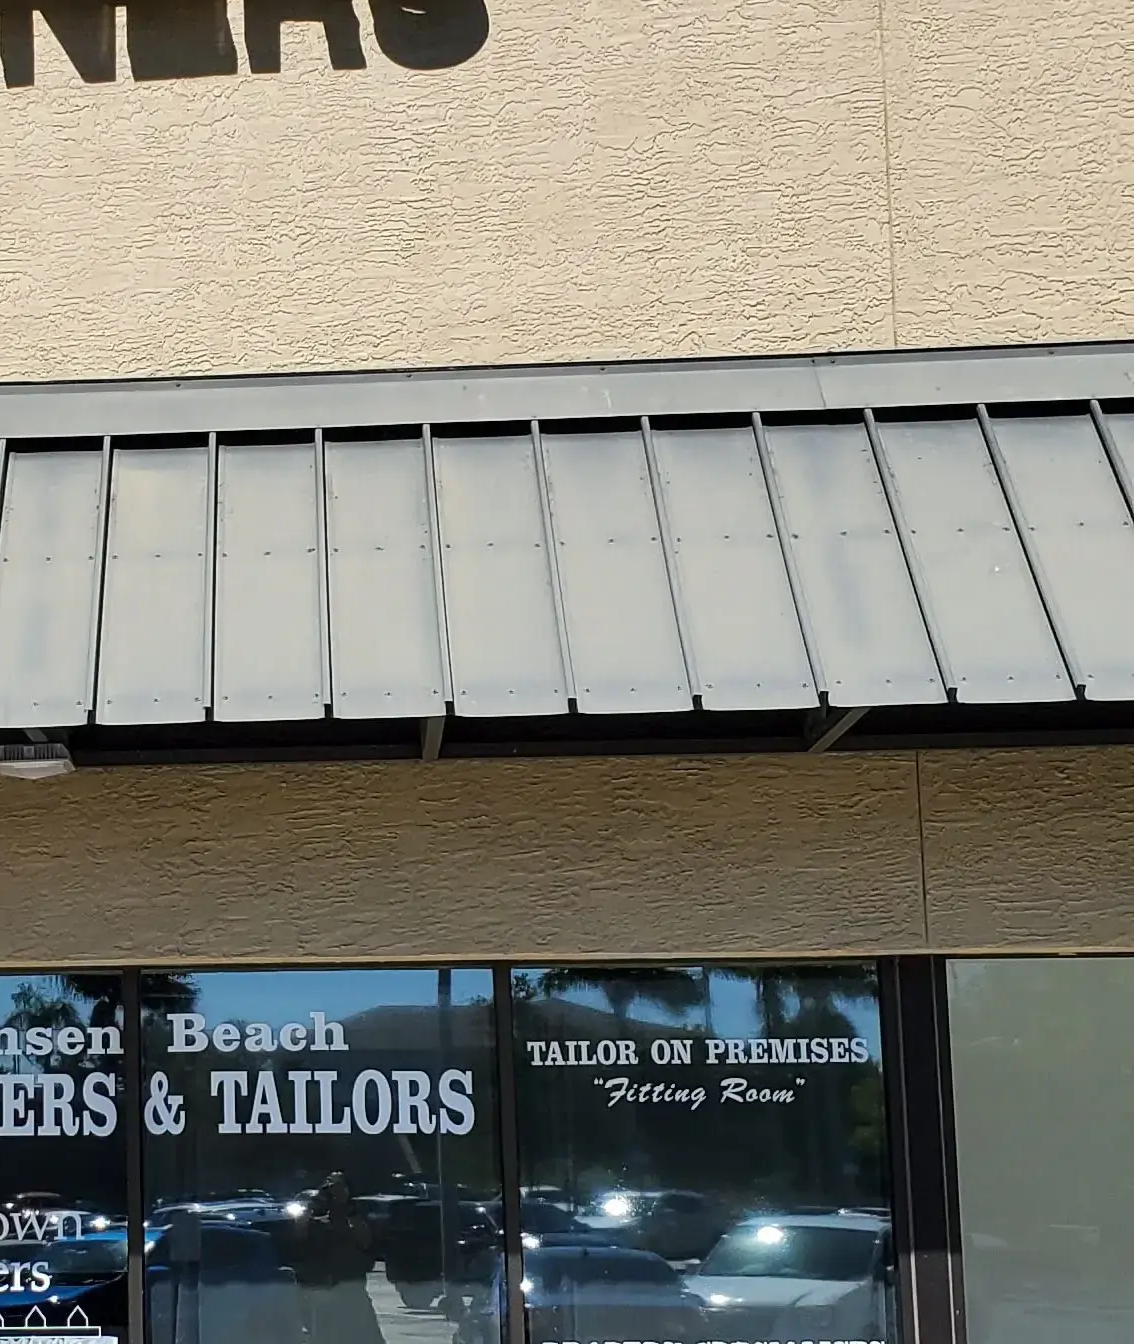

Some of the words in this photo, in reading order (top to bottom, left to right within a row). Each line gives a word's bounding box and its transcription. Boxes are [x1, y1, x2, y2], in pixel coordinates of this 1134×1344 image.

[167, 1012, 350, 1053] Beach
[527, 1040, 639, 1066] TAILOR
[651, 1039, 693, 1065] ON
[706, 1037, 869, 1064] PREMISES
[144, 1071, 186, 1135] &
[210, 1069, 475, 1135] TAILORS
